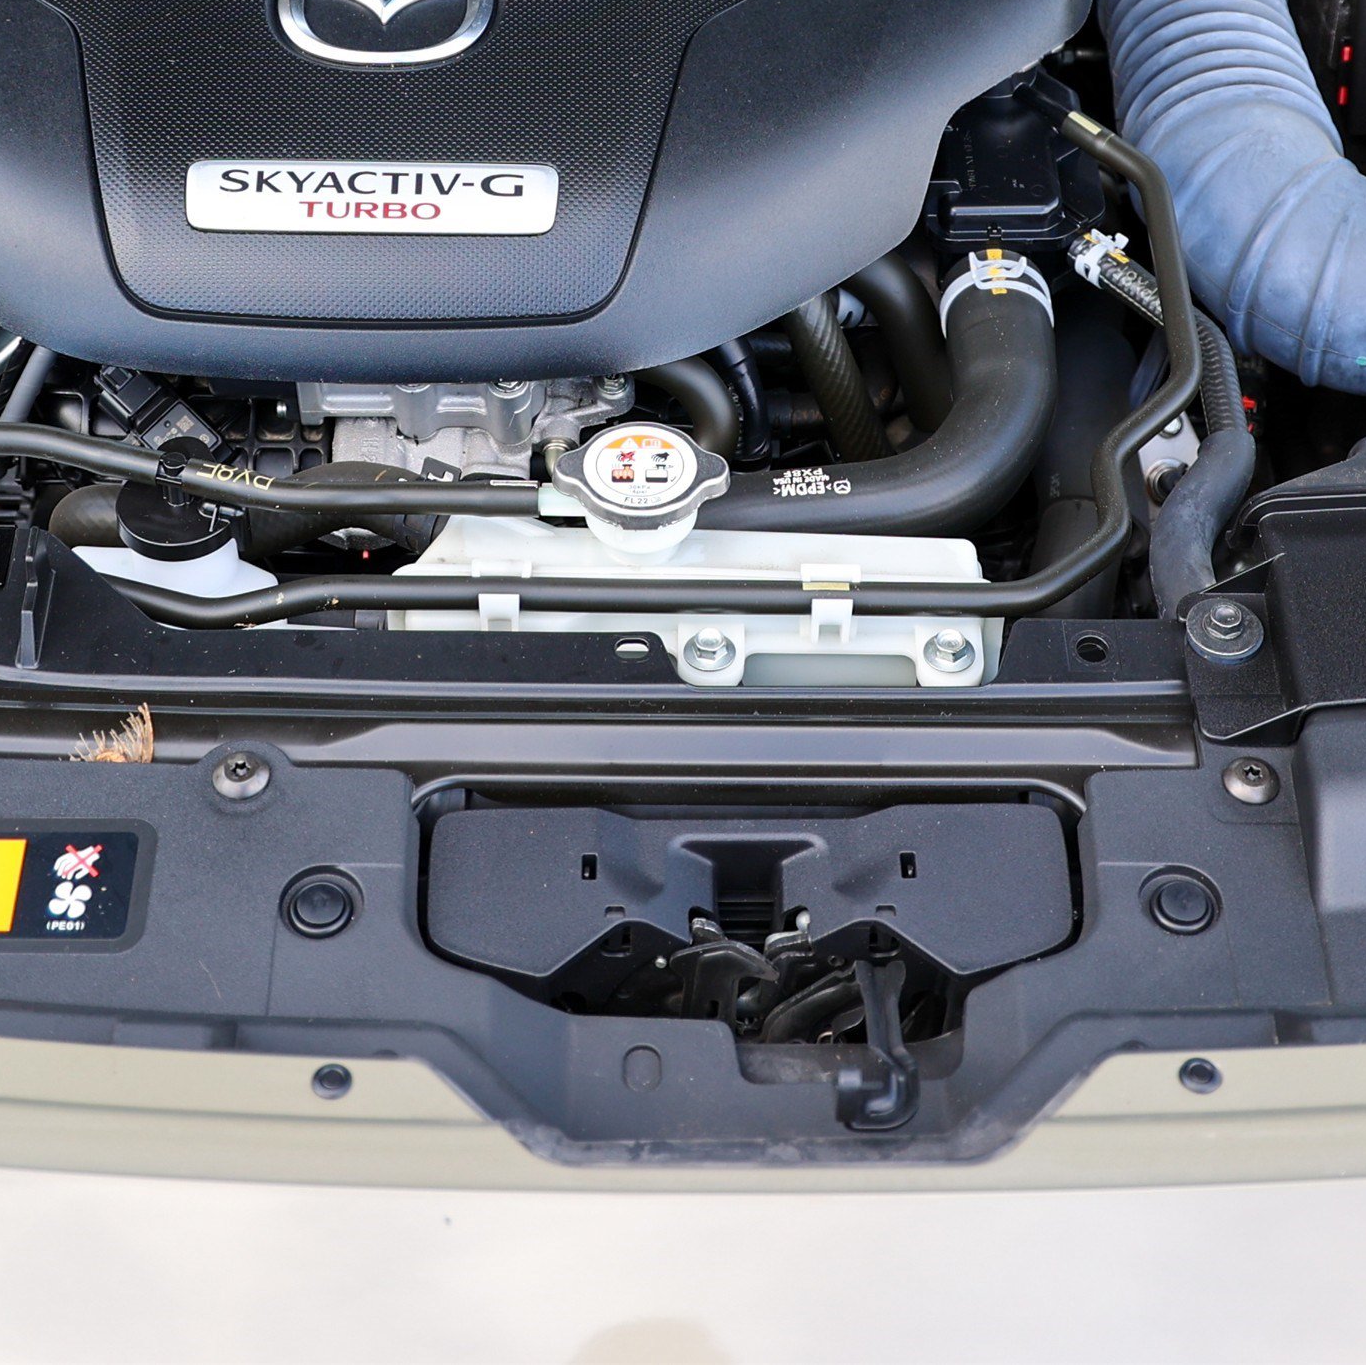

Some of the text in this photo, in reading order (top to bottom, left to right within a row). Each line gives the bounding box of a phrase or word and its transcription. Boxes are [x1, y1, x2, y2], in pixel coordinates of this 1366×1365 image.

[218, 169, 525, 197] SKYACTIV-G
[299, 200, 442, 221] TURBO
[46, 920, 86, 931] (PE01)
